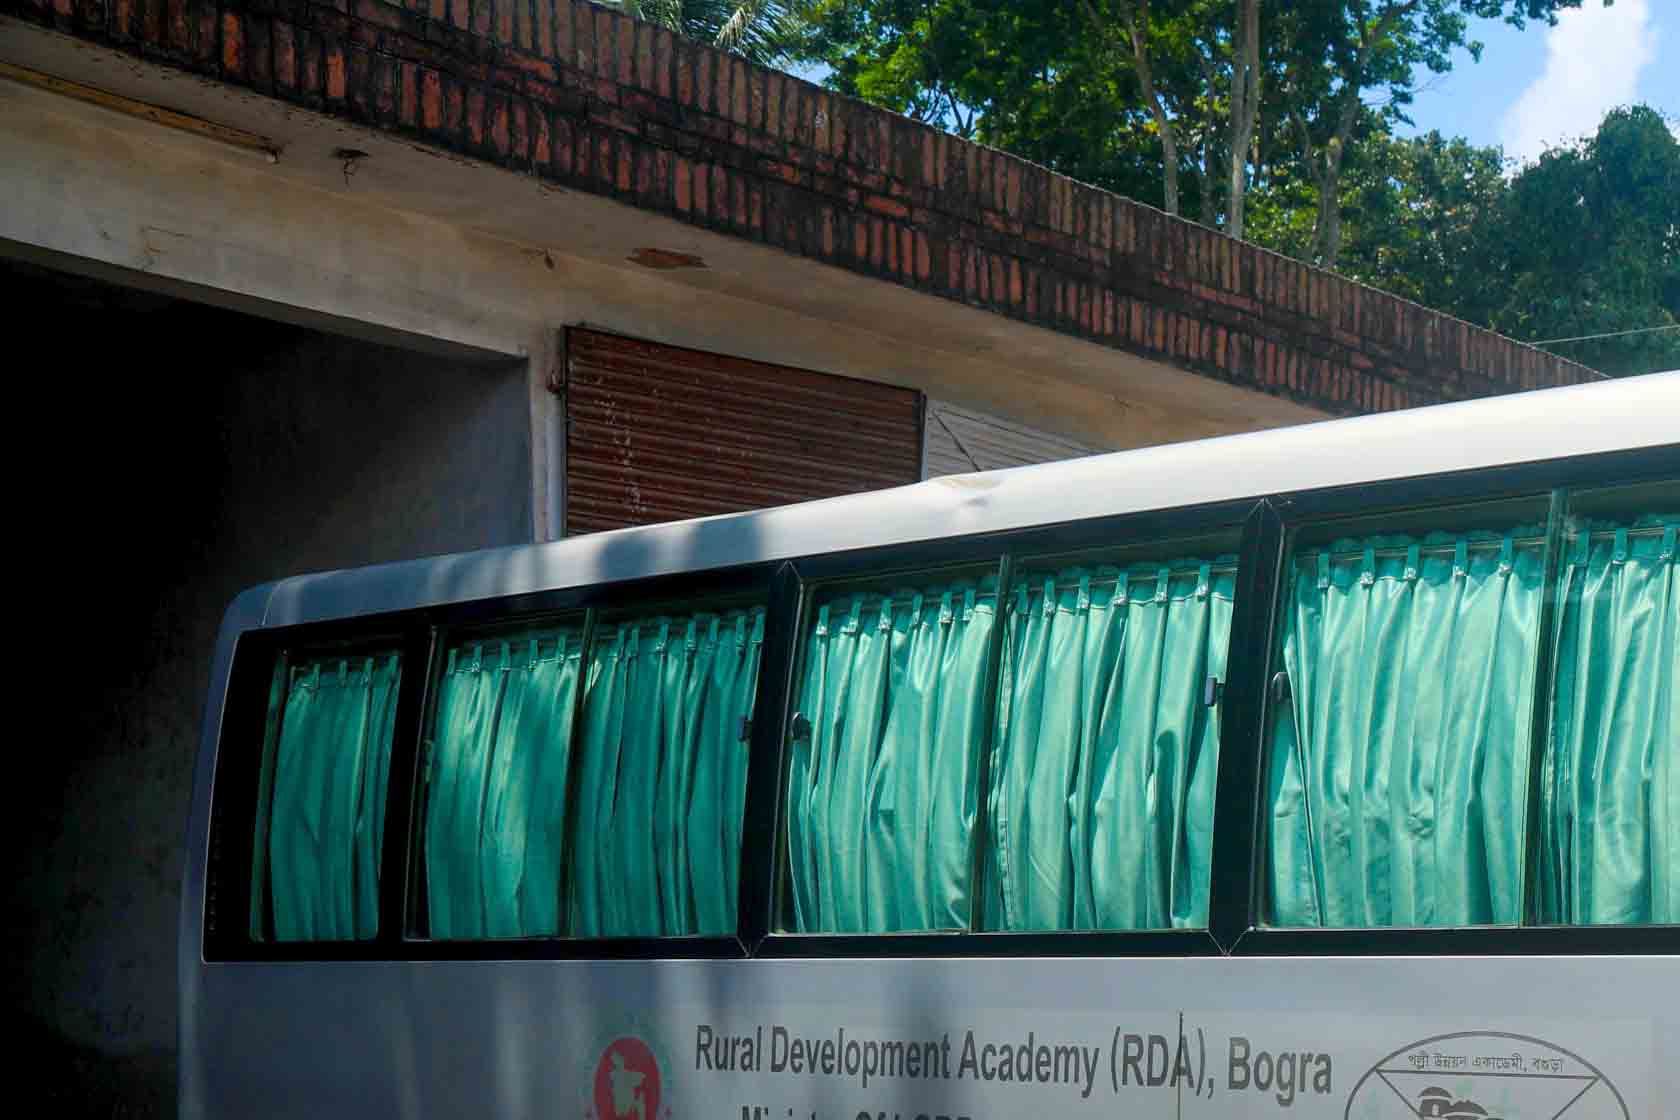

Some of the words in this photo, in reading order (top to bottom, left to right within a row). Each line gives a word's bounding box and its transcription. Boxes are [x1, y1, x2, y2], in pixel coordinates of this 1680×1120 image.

[695, 1024, 762, 1073] Rural
[770, 1026, 951, 1088] Development
[957, 1030, 1100, 1098] Academy
[1111, 1026, 1214, 1099] (RDA),
[1227, 1036, 1333, 1107] Bogra
